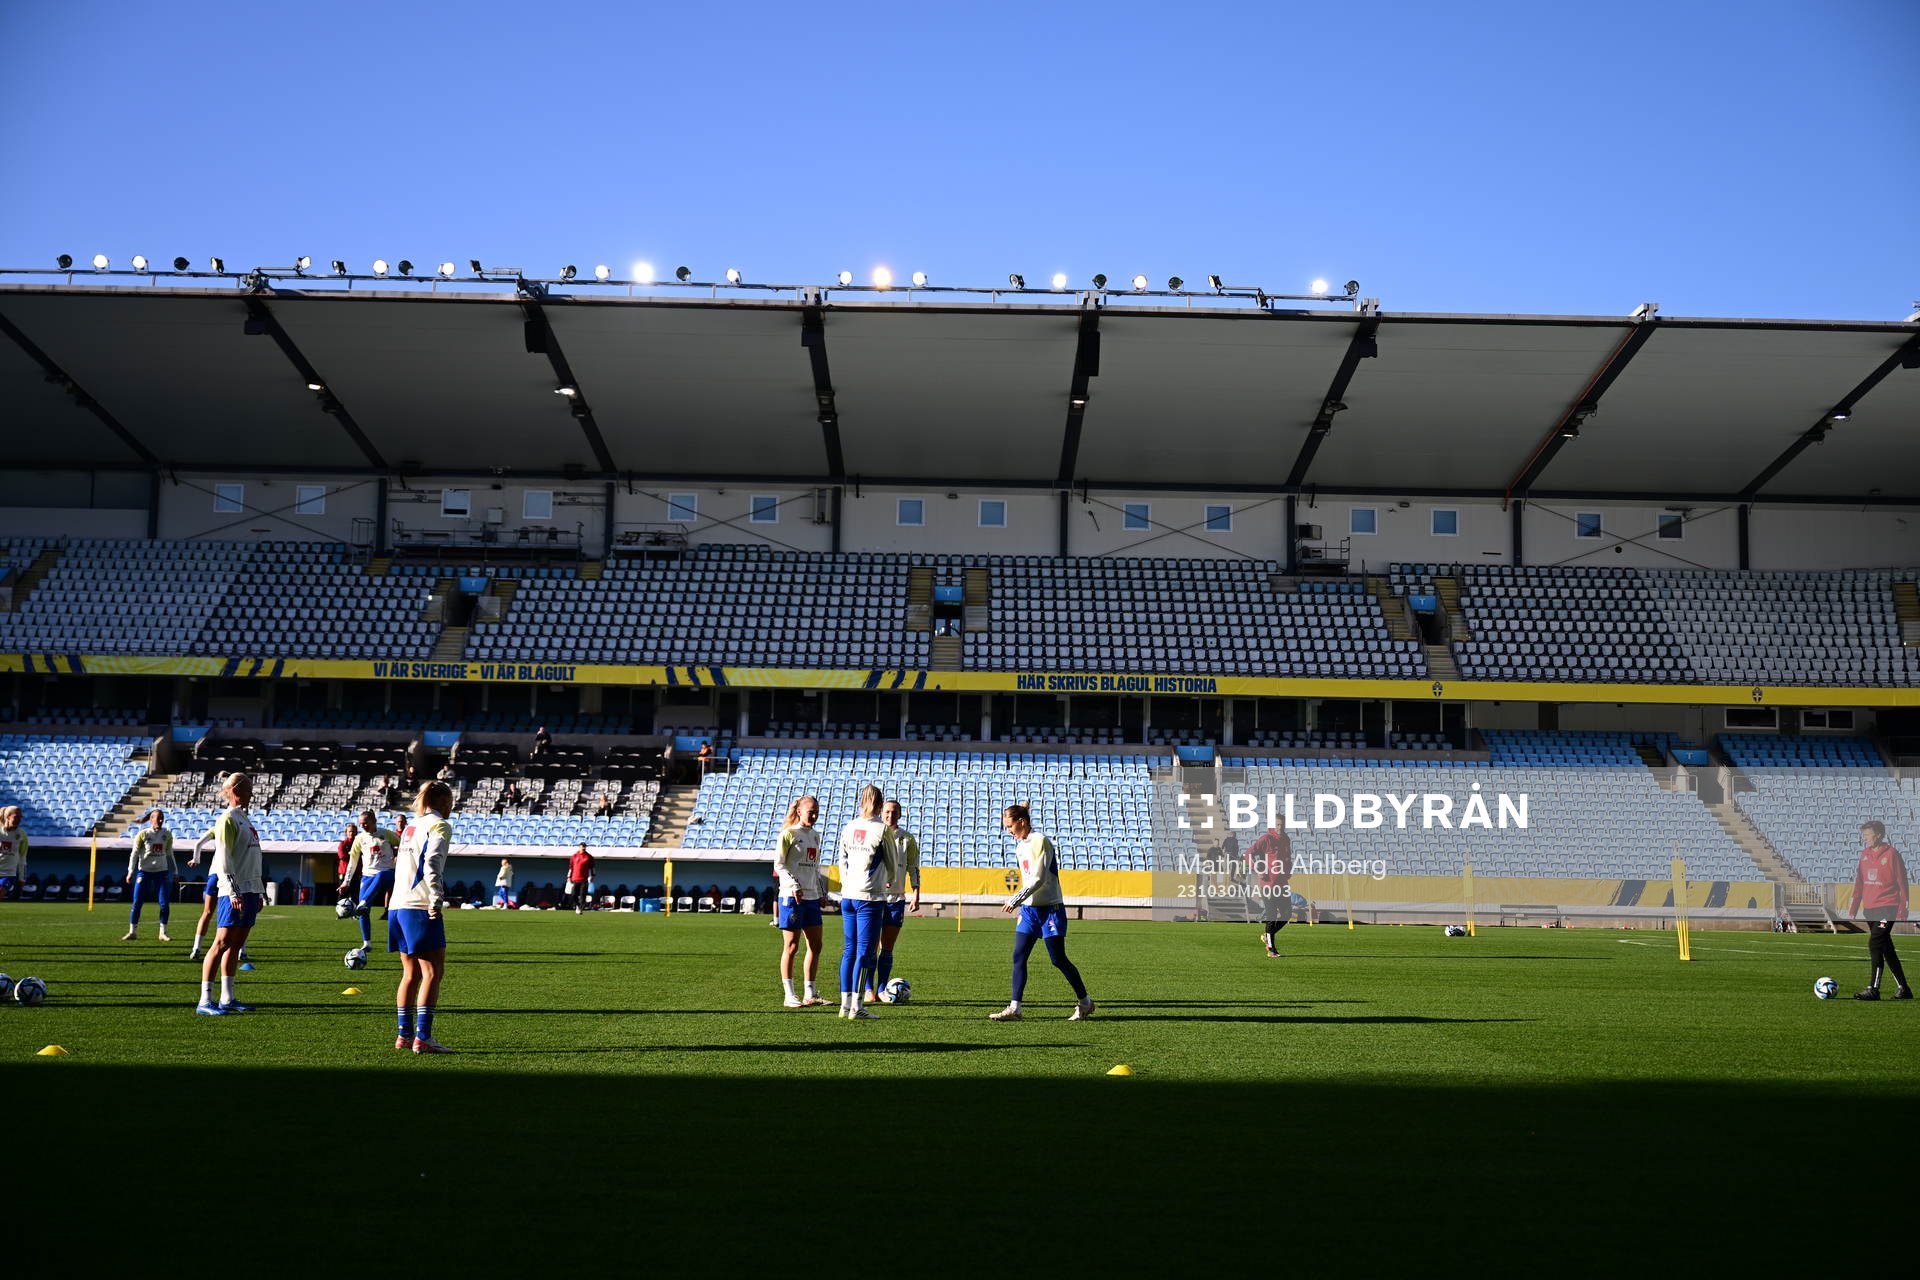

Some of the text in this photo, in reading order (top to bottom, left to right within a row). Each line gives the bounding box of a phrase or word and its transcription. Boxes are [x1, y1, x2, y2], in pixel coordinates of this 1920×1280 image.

[374, 662, 388, 677] VI
[390, 661, 409, 678] ÄR
[412, 663, 468, 679] SVERIGE
[480, 664, 495, 679] VI
[497, 664, 516, 680] ÄR
[1017, 674, 1046, 689] HÄR
[1048, 675, 1098, 691] SKRIVS
[1154, 677, 1217, 693] HISTORIA
